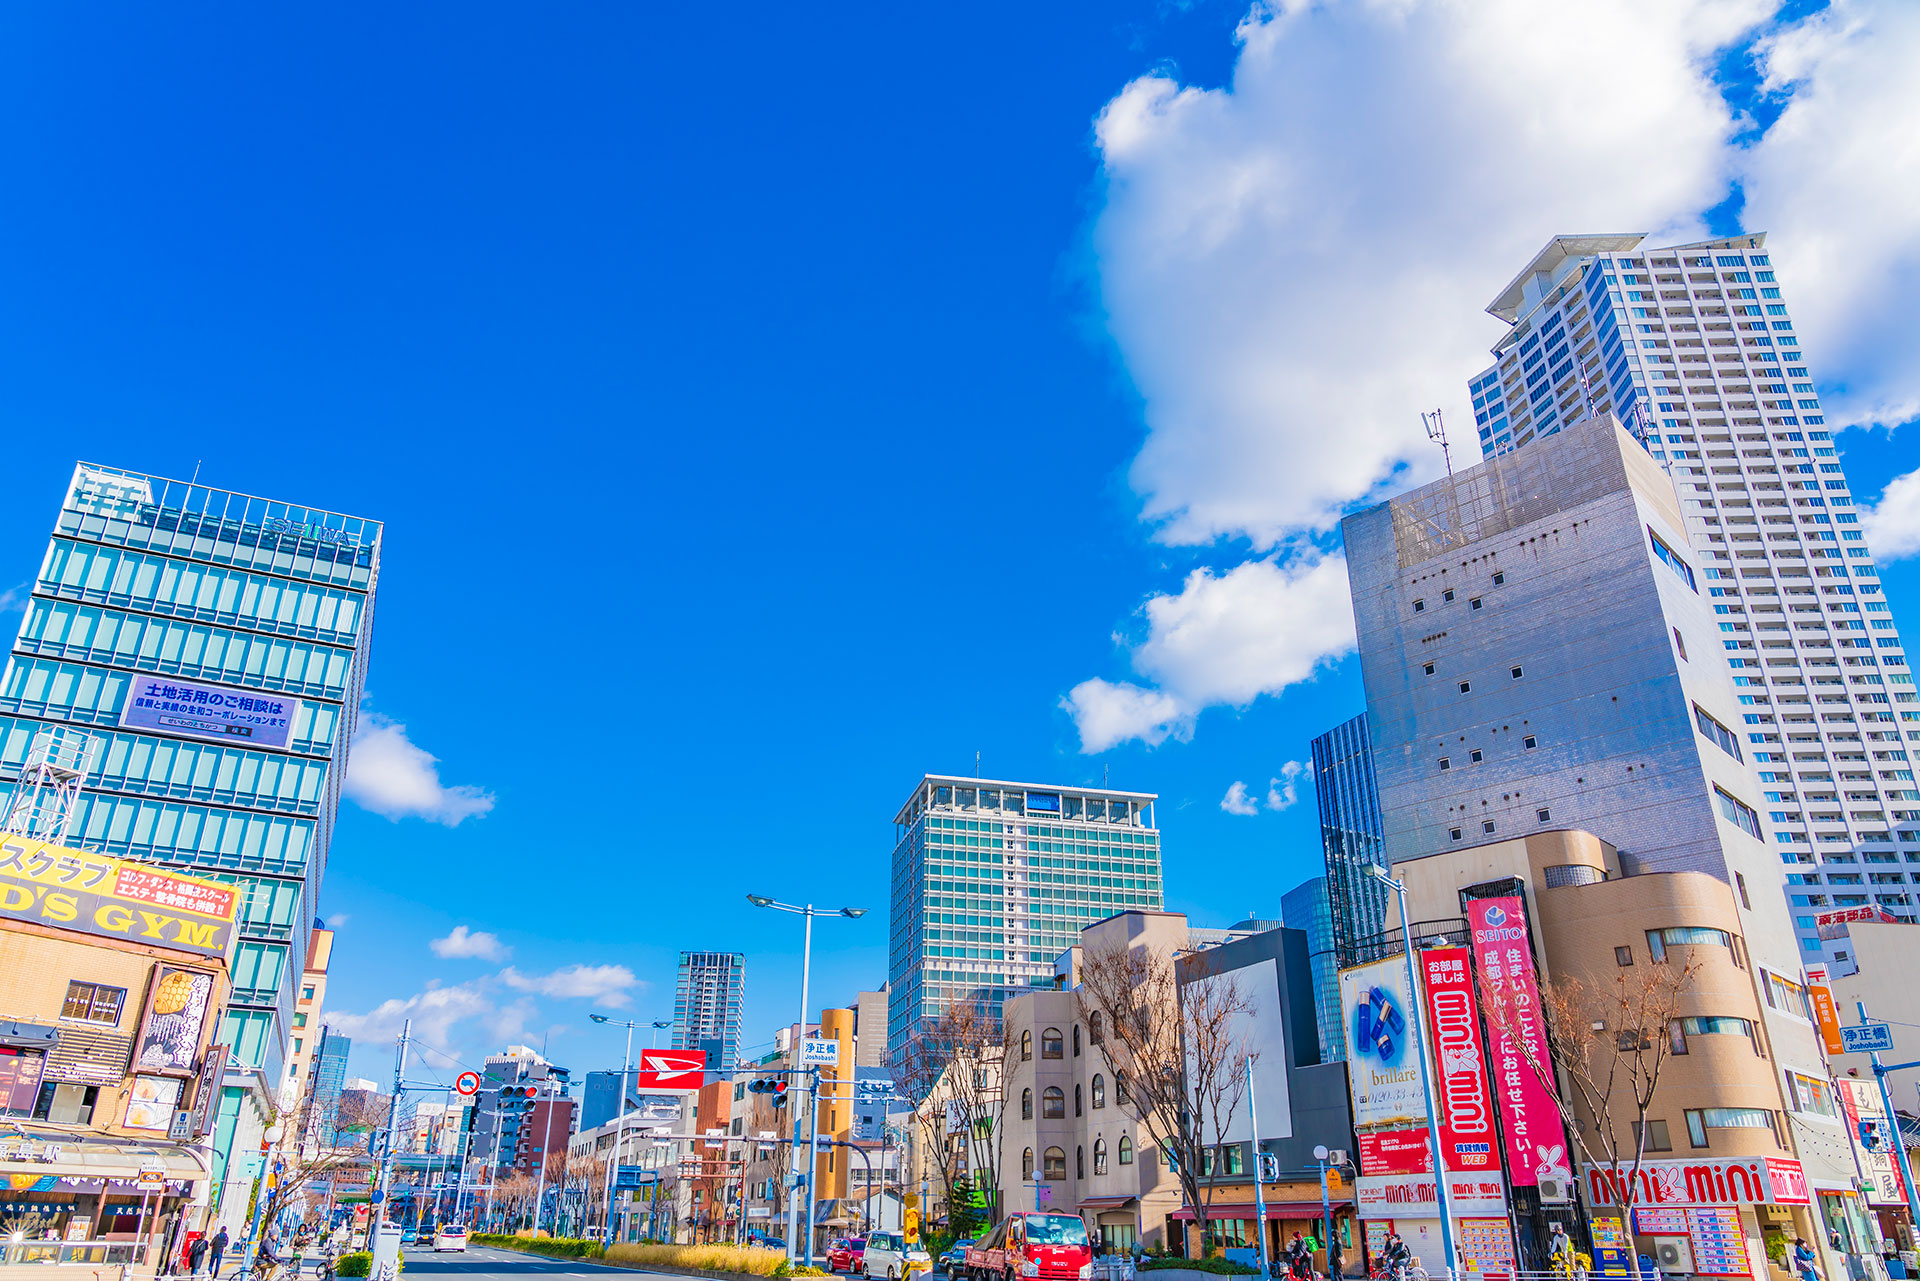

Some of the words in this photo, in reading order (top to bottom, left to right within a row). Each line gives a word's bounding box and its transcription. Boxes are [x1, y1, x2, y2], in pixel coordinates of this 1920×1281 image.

[145, 684, 283, 715] 土地活用のご相談は
[136, 697, 286, 727] 信頼と実績の生和コーポレーションまで
[0, 844, 112, 888] スクラブ
[1477, 927, 1522, 943] SEITO
[1429, 959, 1464, 972] お部屋
[1430, 972, 1465, 985] 探しは
[1433, 990, 1475, 1052] mini
[1820, 1003, 1832, 1024] 郵便局
[1844, 1027, 1887, 1042] 浄正橋
[805, 1042, 836, 1054] 浄正橋
[1848, 1040, 1888, 1050] Joshobashi
[1371, 1067, 1417, 1086] brillare
[1447, 1069, 1488, 1133] mini
[1455, 1143, 1490, 1153] 賃貸情報
[1461, 1154, 1487, 1165] WEB
[1452, 1183, 1474, 1194] mini
[1479, 1183, 1501, 1194] mini
[1589, 1167, 1662, 1204] mini
[1683, 1164, 1765, 1204] mini
[1385, 1184, 1409, 1203] mini
[1417, 1183, 1438, 1203] min
